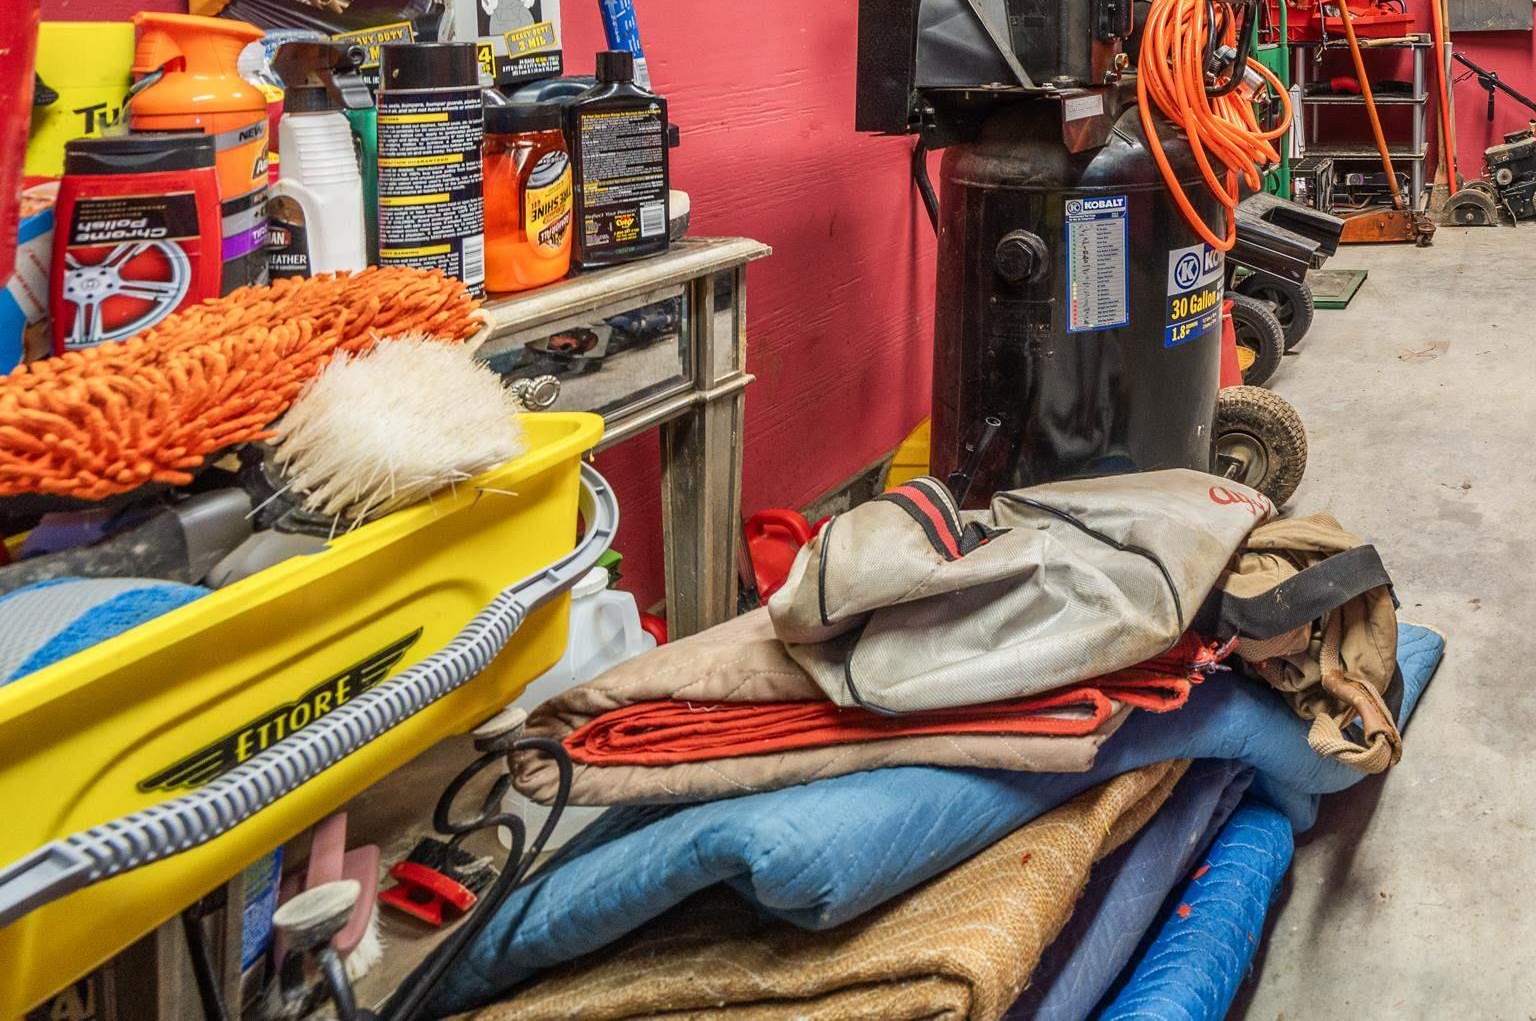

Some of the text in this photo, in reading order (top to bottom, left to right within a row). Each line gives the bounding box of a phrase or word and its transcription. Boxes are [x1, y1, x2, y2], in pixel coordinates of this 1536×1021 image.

[356, 30, 403, 46] AVY DUTY
[478, 47, 492, 63] 4
[530, 196, 559, 222] SHINE
[1085, 198, 1124, 210] KOBALT
[77, 218, 148, 232] Polish
[75, 226, 168, 242] Chrome
[1171, 289, 1217, 320] 30 Gallon
[1171, 324, 1186, 342] 1.8
[235, 675, 351, 763] ETTORE
